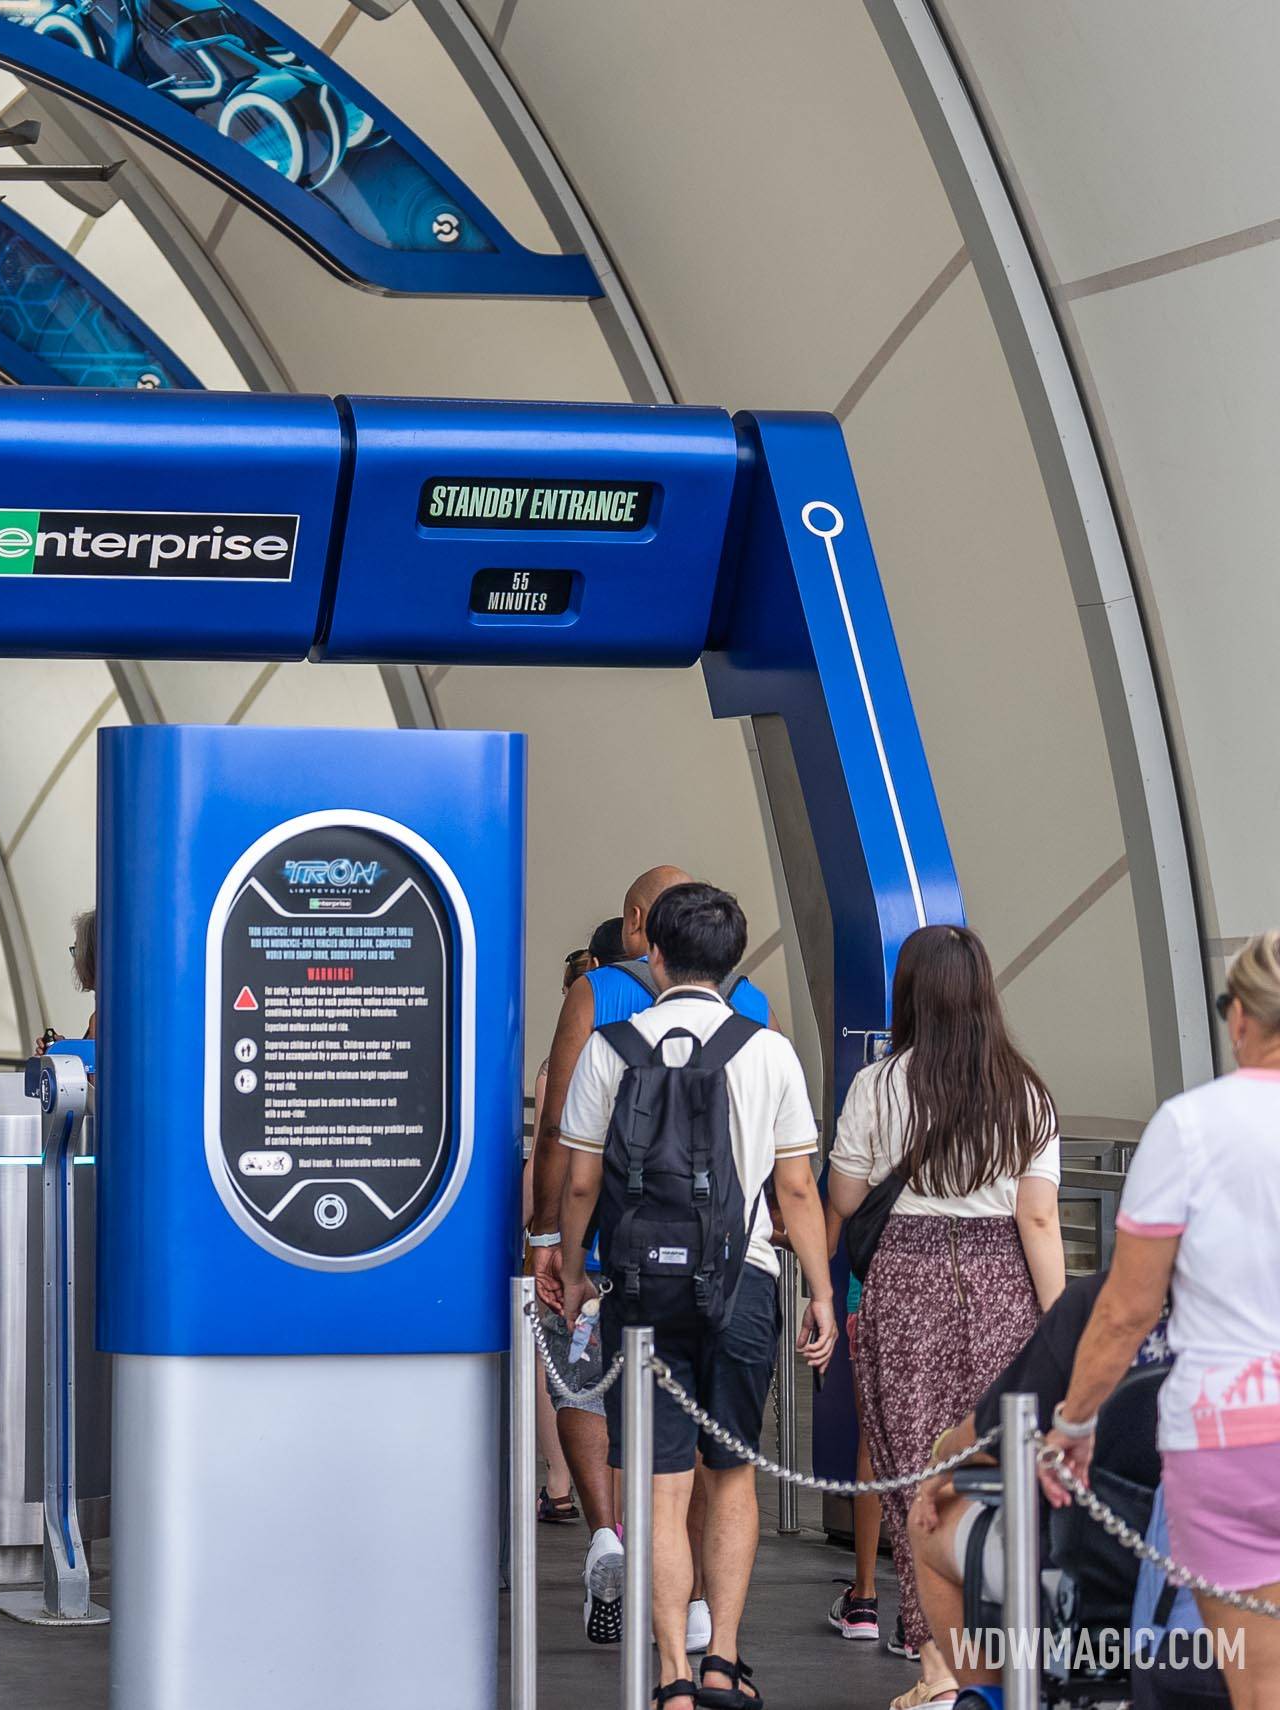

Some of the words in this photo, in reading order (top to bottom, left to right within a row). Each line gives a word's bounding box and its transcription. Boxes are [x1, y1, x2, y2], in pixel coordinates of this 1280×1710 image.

[429, 485, 529, 520] STANDBY
[531, 488, 639, 522] ENTRANCE
[512, 572, 530, 590] 55
[488, 591, 548, 611] MINUTES
[285, 859, 378, 886] TRON
[307, 968, 354, 981] WARNING!
